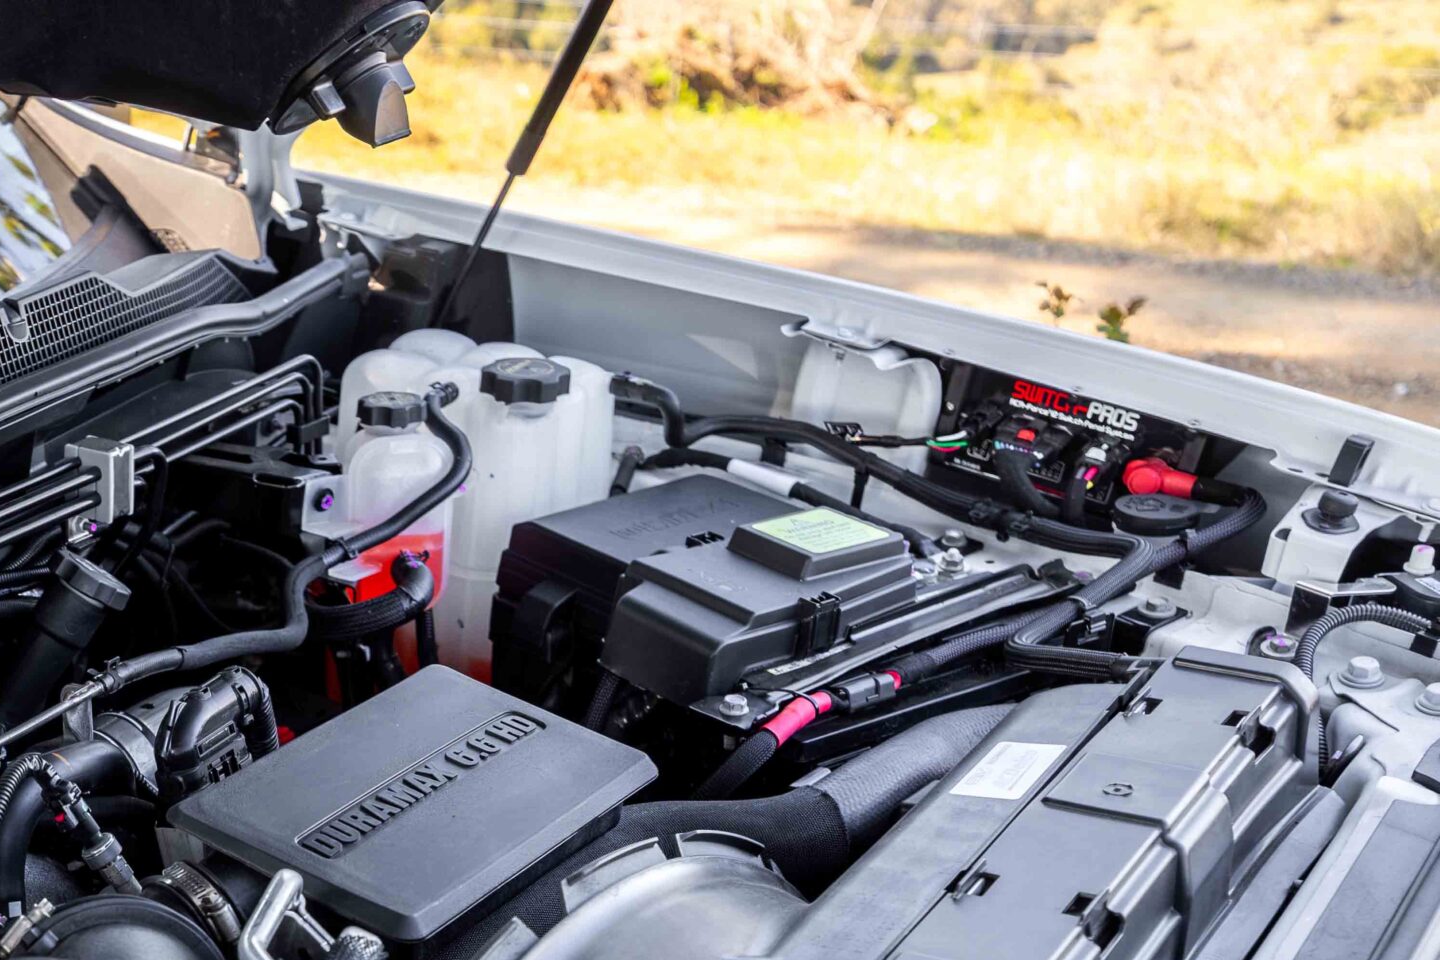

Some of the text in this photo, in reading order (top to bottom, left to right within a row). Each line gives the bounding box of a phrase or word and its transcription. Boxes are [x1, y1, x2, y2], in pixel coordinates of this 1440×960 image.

[302, 714, 537, 859] DURAMAX 6.6 HD
